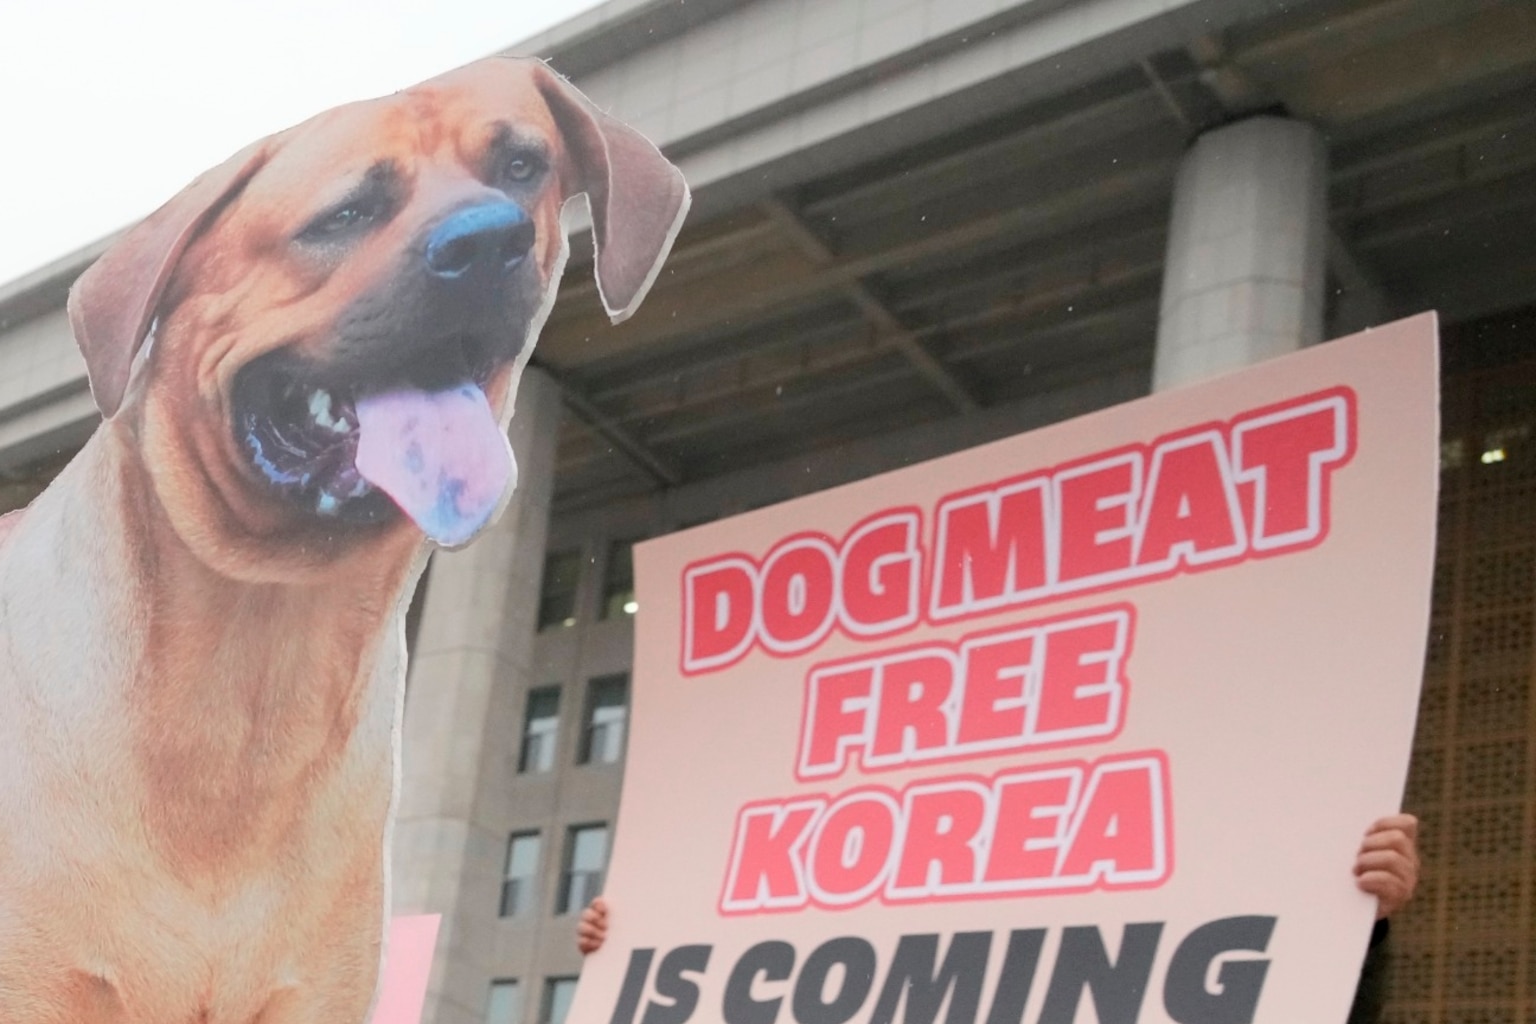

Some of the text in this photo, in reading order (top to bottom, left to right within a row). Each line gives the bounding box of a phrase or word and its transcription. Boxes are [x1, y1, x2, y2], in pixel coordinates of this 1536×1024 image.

[681, 385, 1358, 675] DOG MEAT
[795, 603, 1136, 782] FREE
[719, 749, 1174, 916] KOREA
